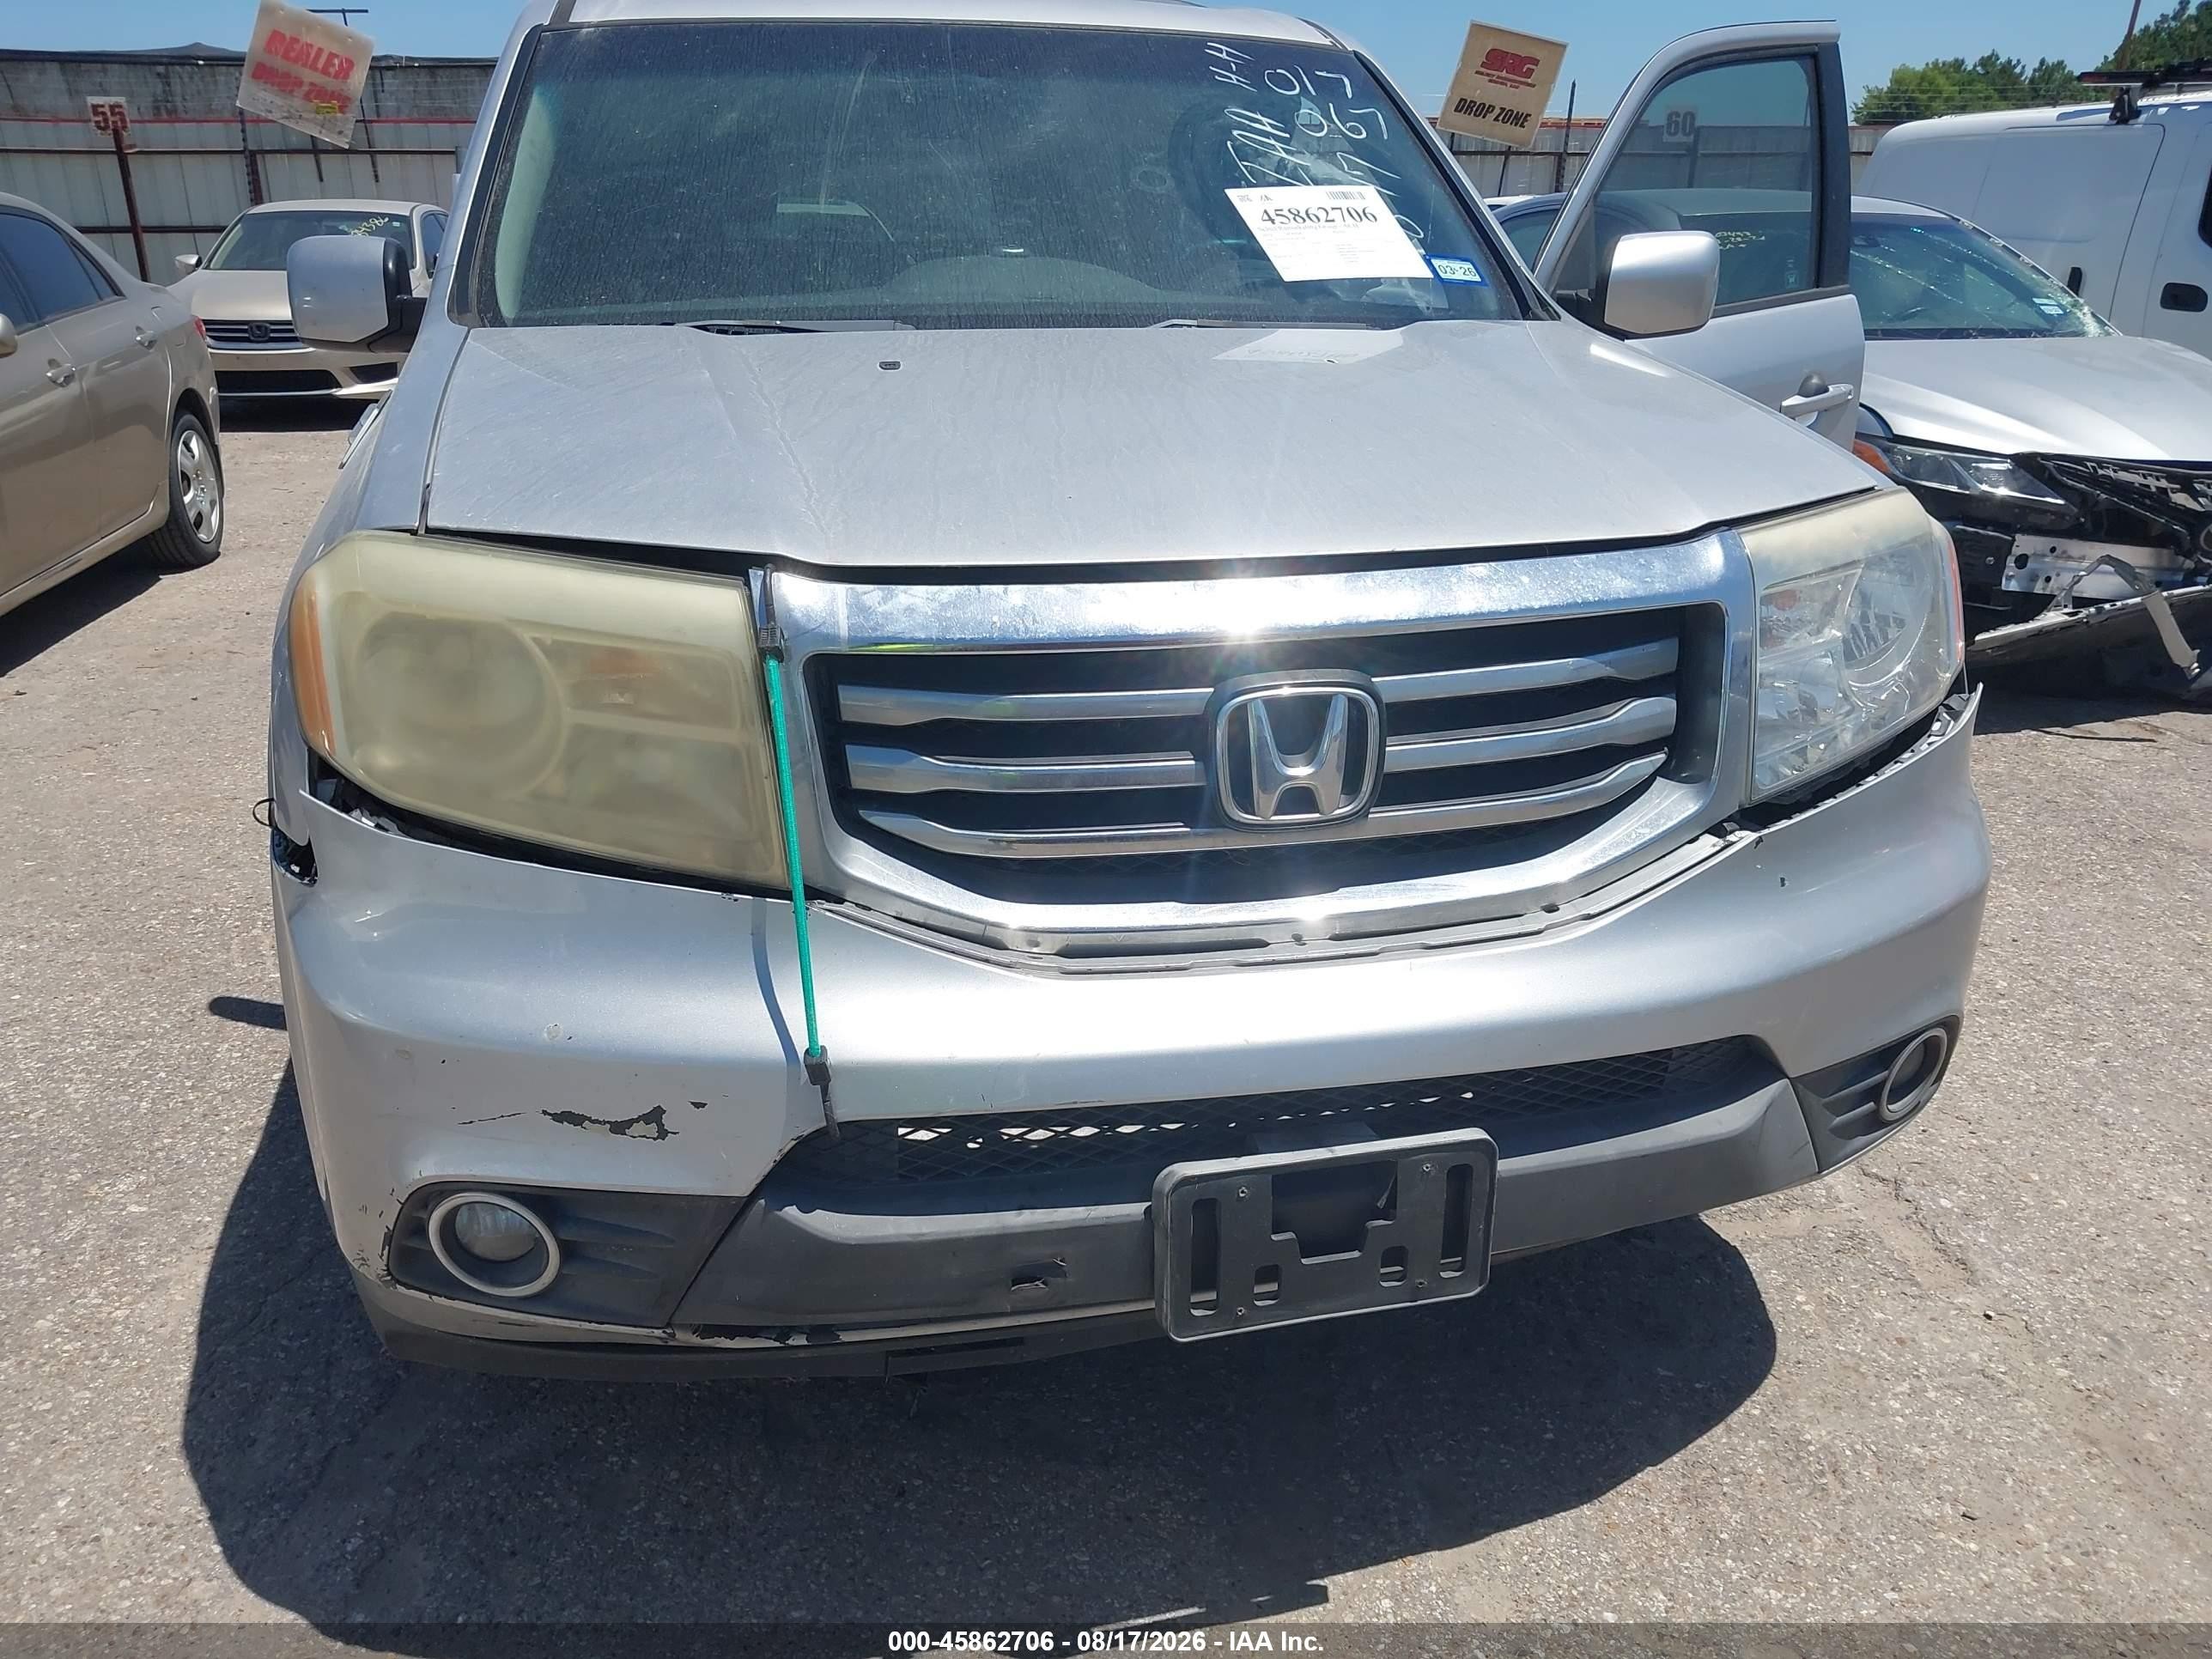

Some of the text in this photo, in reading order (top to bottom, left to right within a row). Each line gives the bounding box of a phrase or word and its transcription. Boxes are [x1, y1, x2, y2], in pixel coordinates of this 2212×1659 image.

[1480, 48, 1540, 79] SRG
[91, 103, 128, 131] 55
[1454, 97, 1532, 129] DROP ZONE
[1666, 111, 1695, 137] 60
[1261, 205, 1378, 225] 45862706
